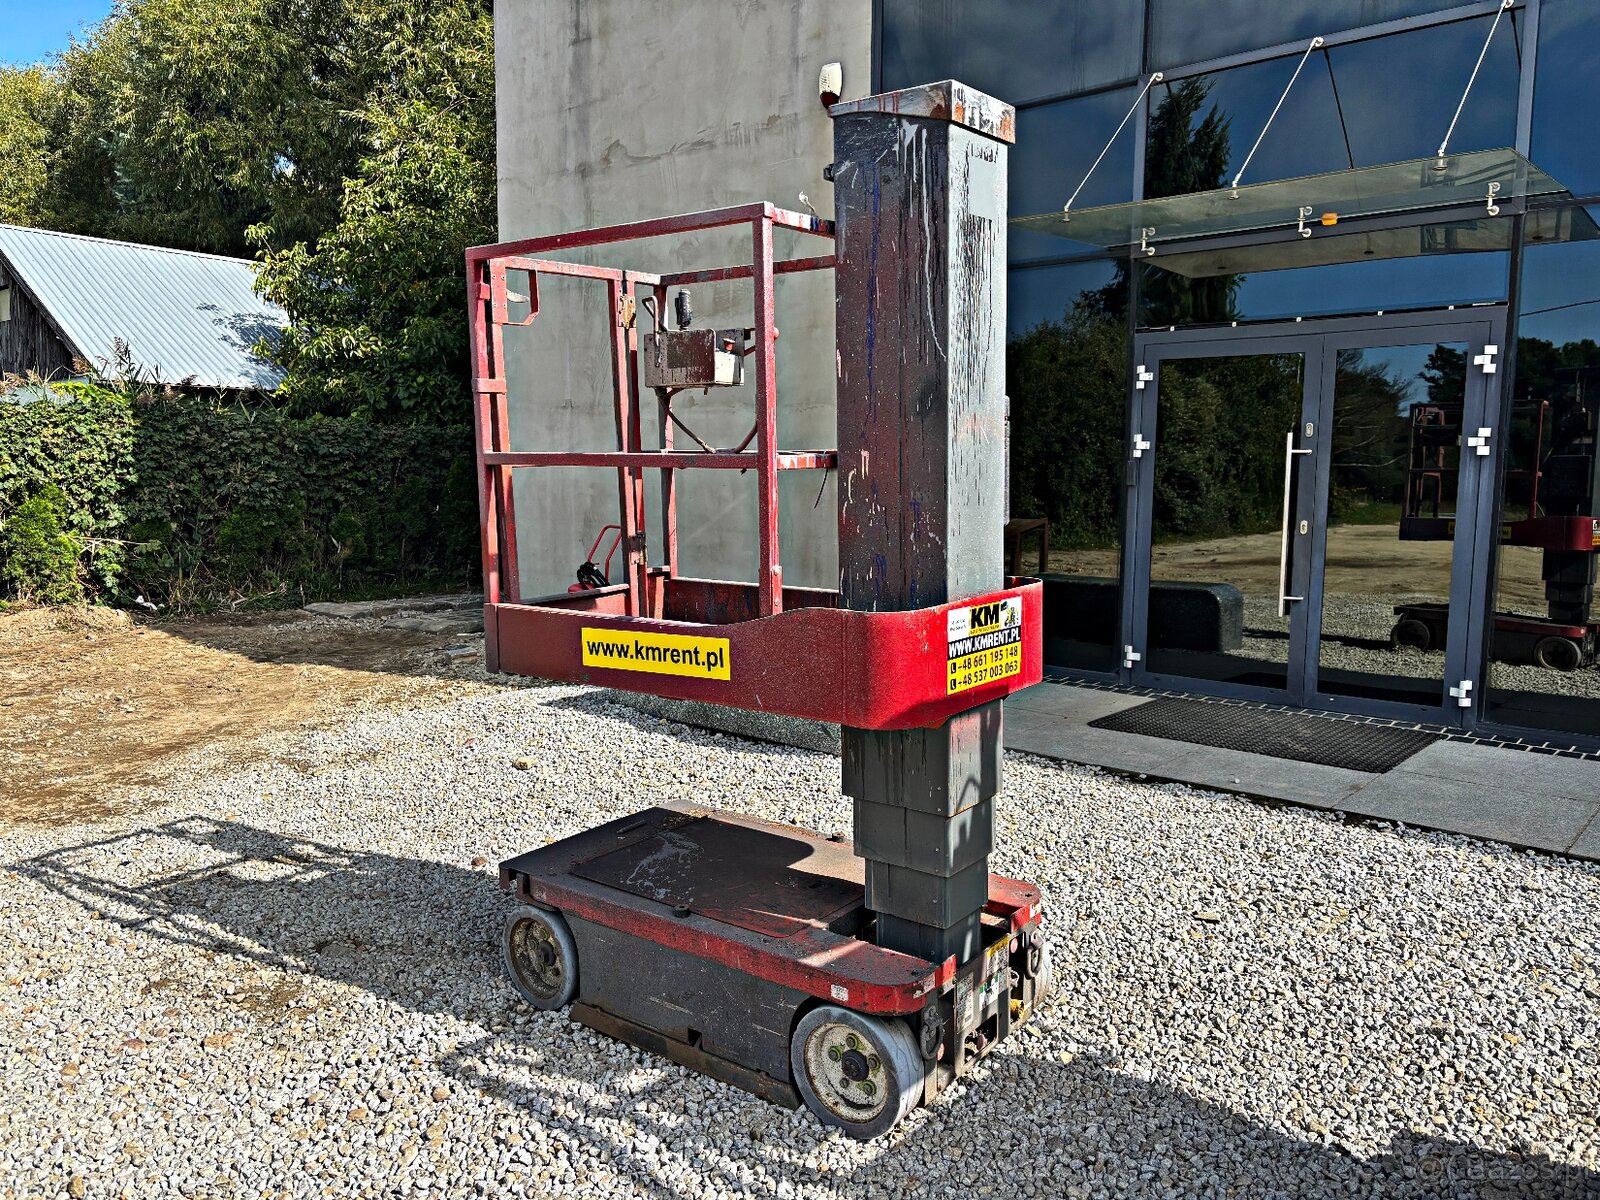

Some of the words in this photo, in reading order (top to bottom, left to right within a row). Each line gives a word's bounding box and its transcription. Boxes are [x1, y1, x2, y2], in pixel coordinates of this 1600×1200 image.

[971, 603, 1000, 629] KM
[948, 627, 1020, 658] WWW.KMRENT.PL
[586, 640, 724, 672] www.kmrent.pl
[973, 653, 987, 669] 661
[990, 650, 1004, 664] 195
[1005, 646, 1018, 660] 148
[974, 669, 988, 683] 537
[990, 665, 1003, 679] 003
[1005, 660, 1018, 674] 063
